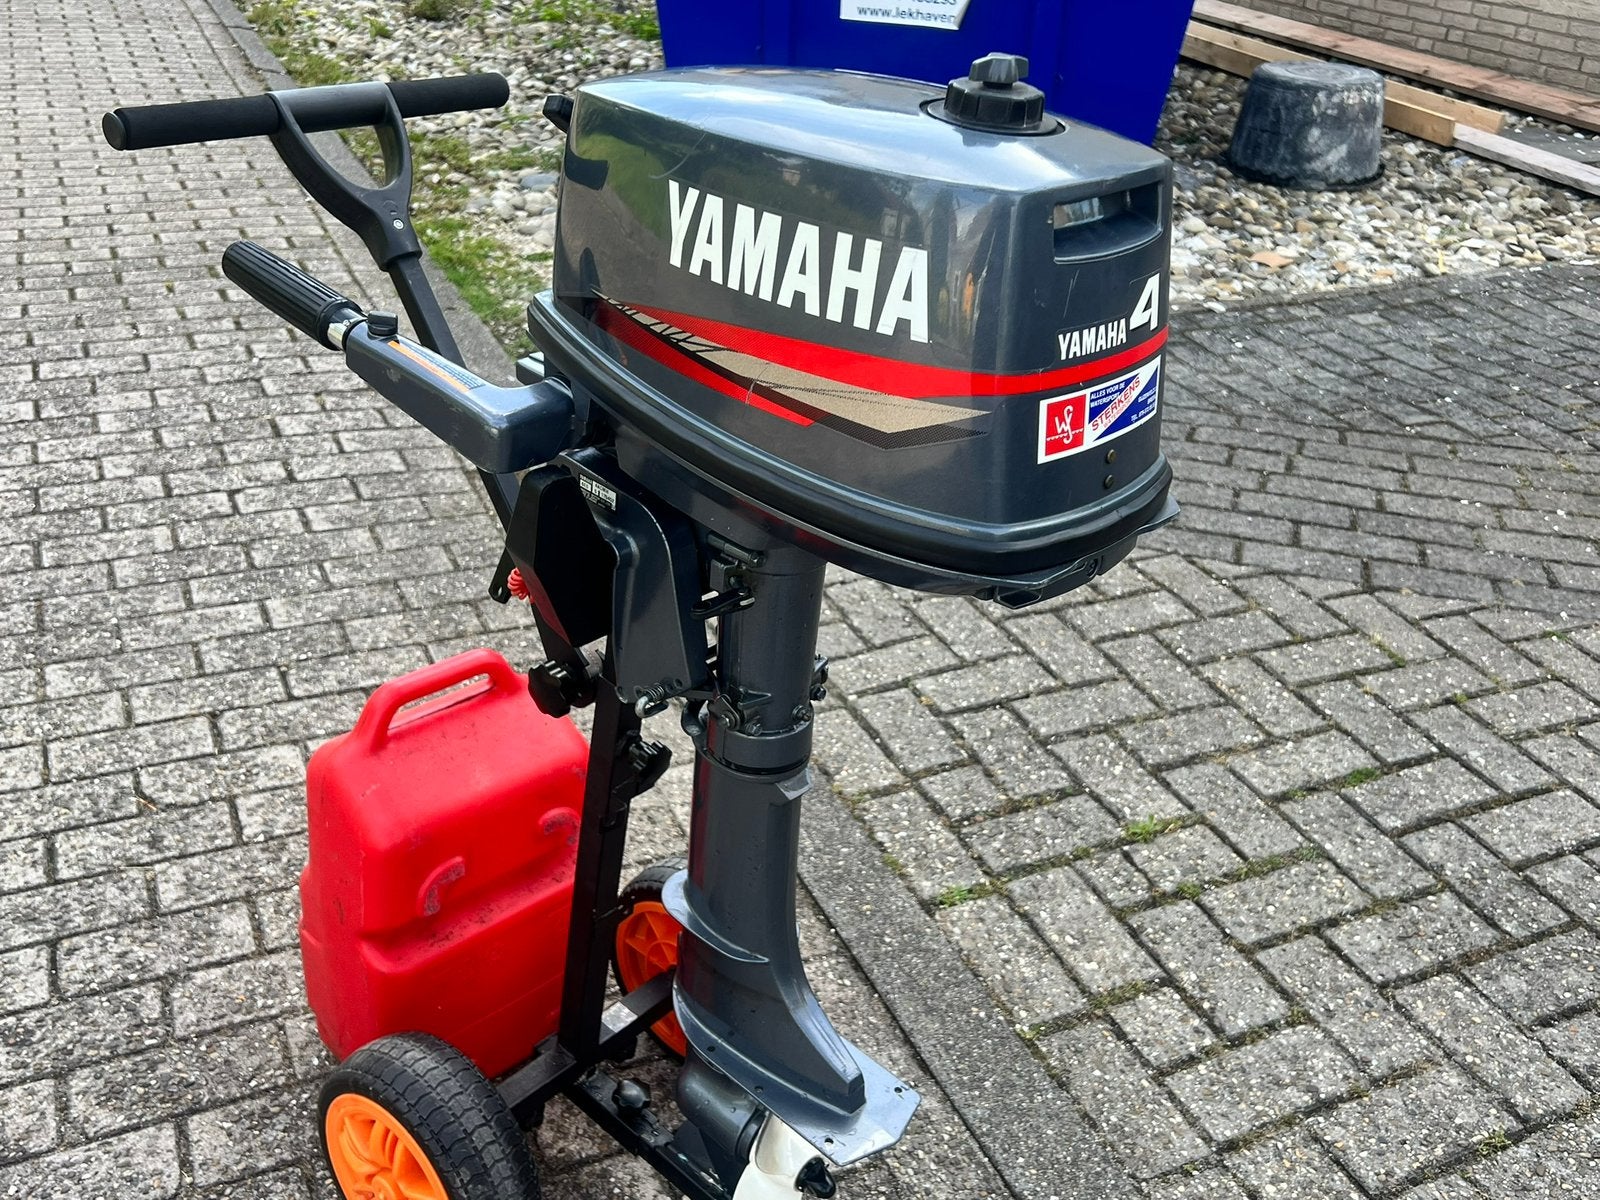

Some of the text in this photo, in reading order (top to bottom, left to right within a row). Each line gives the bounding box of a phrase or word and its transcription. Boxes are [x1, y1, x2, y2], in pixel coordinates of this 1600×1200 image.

[668, 179, 929, 343] YAMAHA
[1058, 272, 1160, 361] YAMAHA 4
[1090, 388, 1106, 400] ALLES
[1091, 377, 1141, 431] STERKENS
